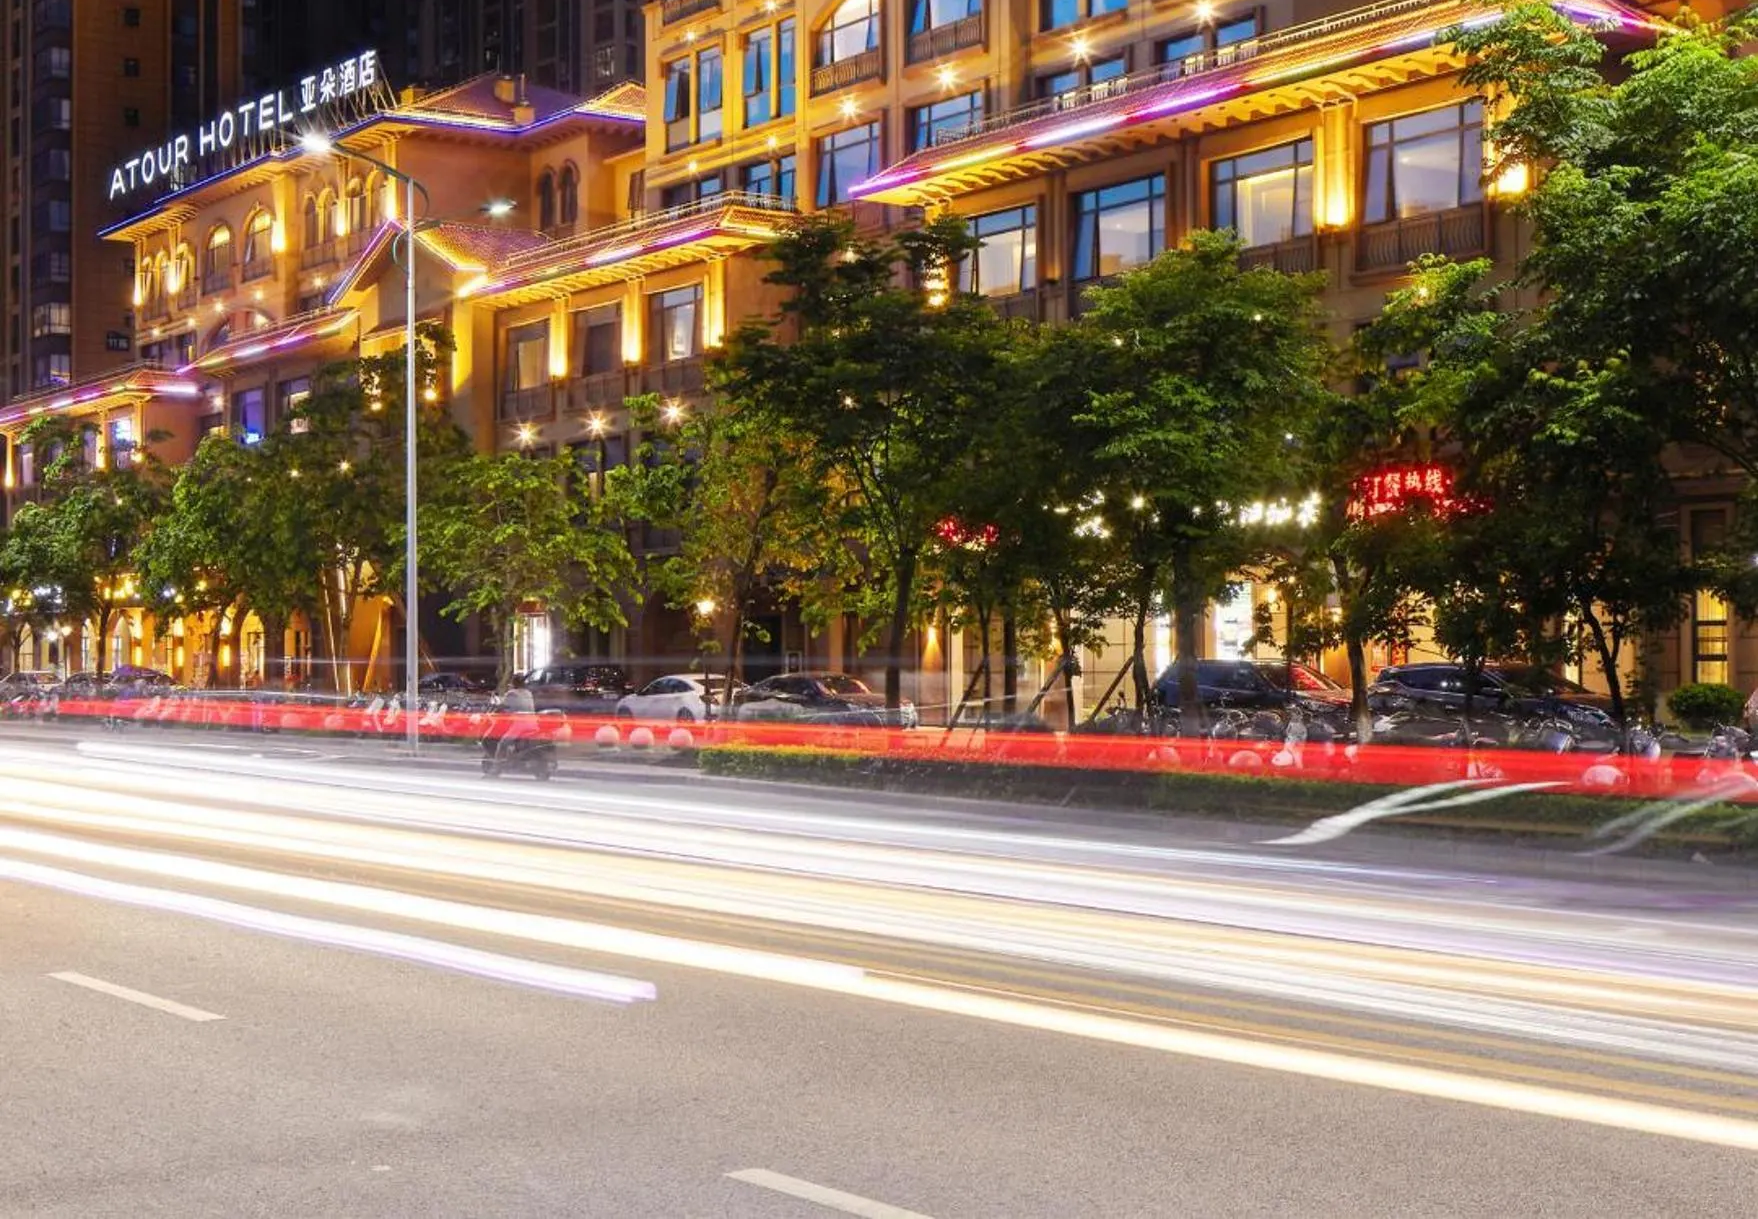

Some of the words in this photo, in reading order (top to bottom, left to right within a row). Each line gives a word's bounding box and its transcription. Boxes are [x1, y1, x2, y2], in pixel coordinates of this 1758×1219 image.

[109, 134, 189, 201] ATOUR
[199, 89, 294, 156] HOTEL
[300, 49, 377, 113] 亚朵酒店
